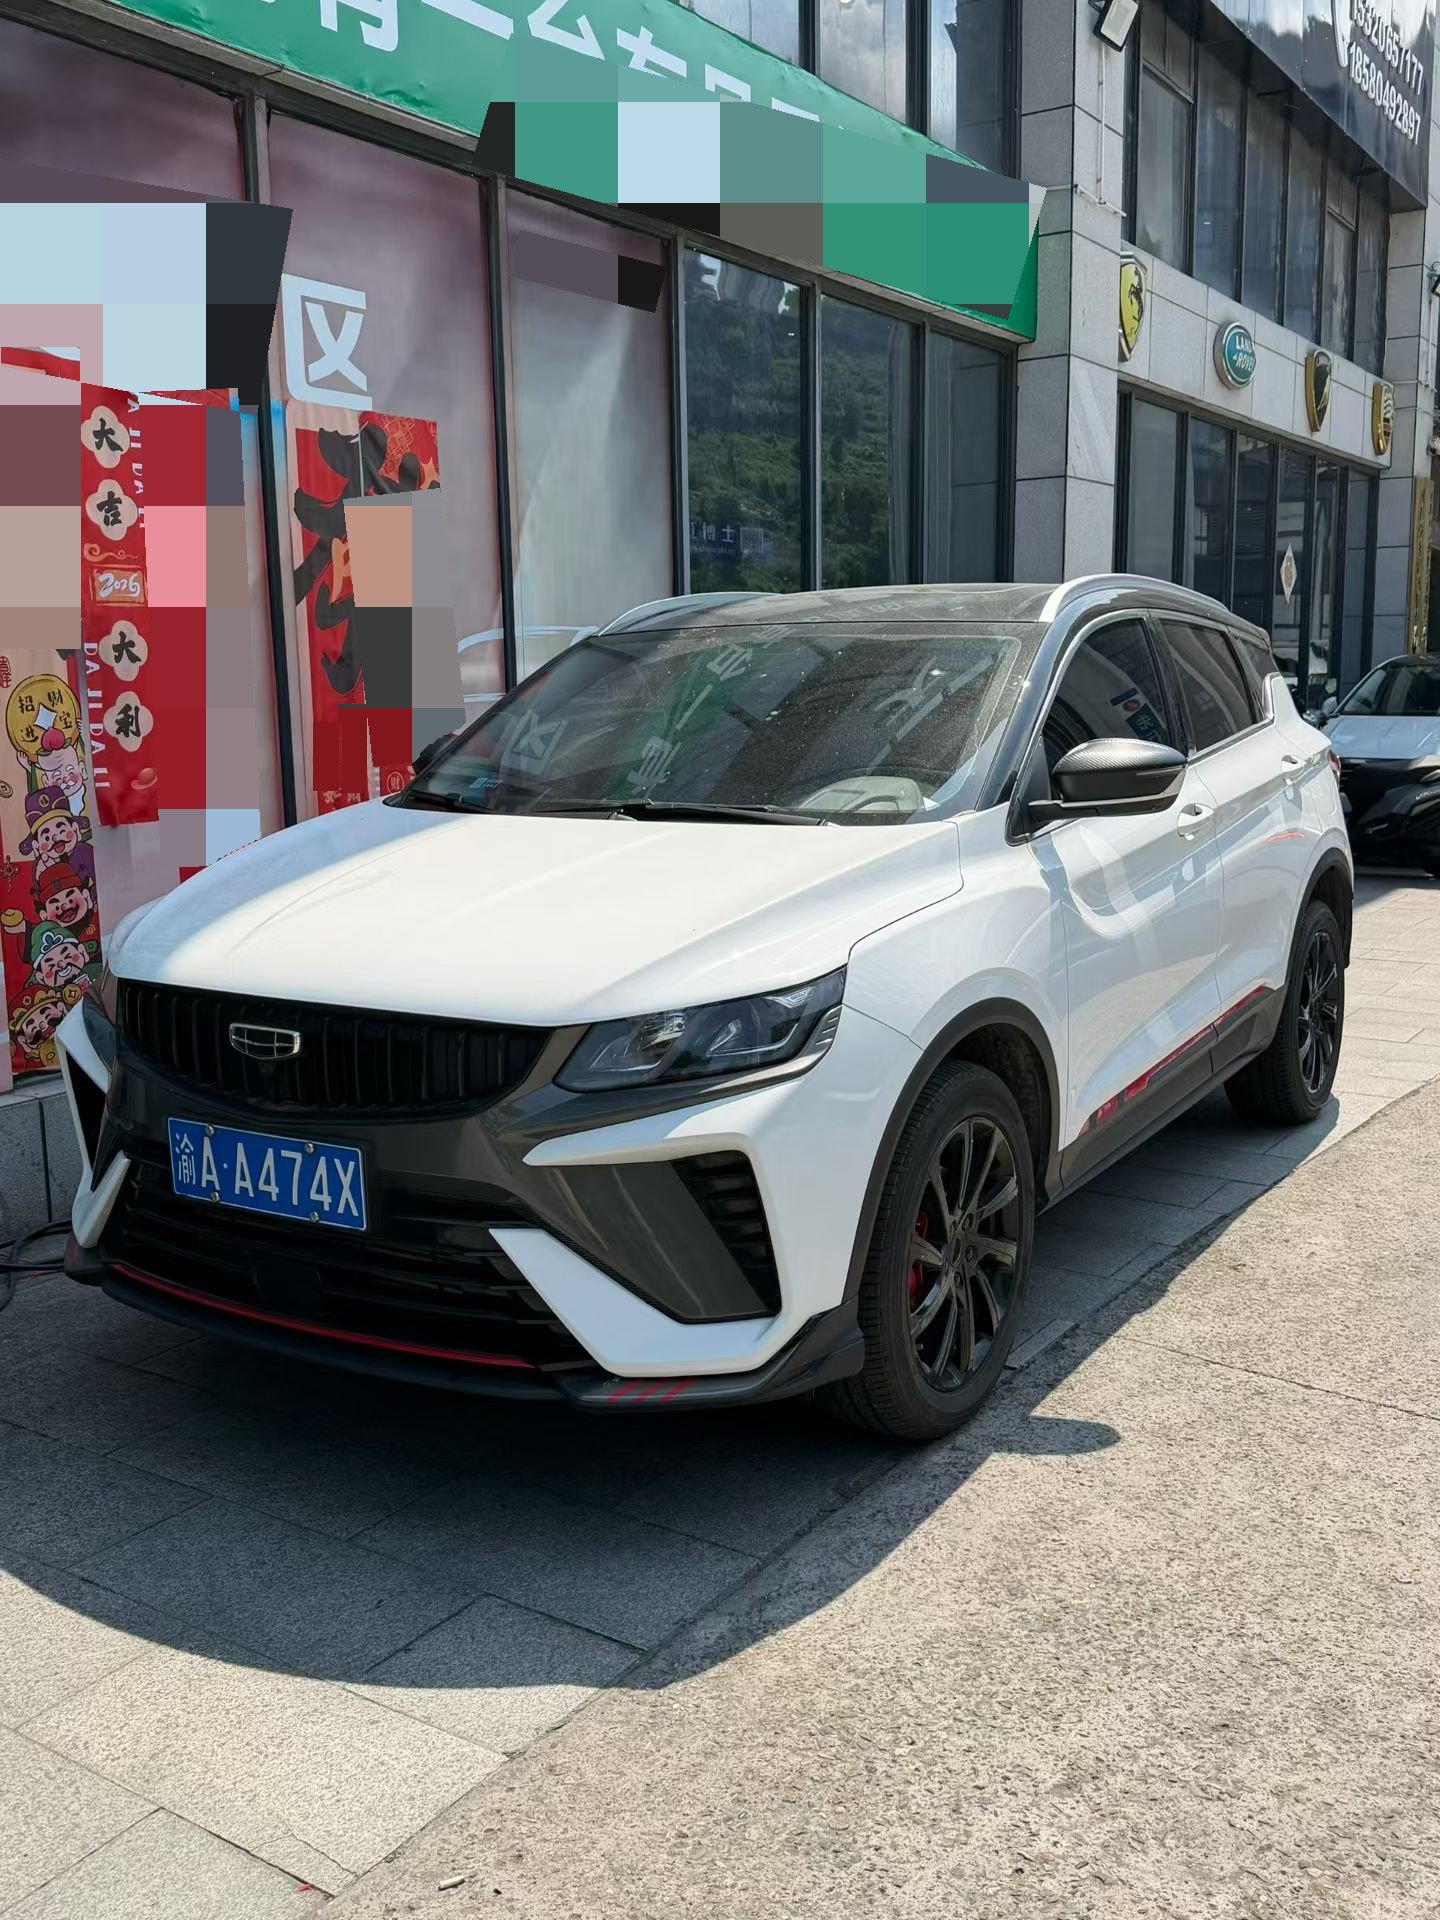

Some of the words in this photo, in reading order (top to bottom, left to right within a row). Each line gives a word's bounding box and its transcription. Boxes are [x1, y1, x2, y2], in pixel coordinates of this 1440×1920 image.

[1349, 41, 1421, 145] 18580492897
[281, 272, 373, 411] 区
[98, 572, 142, 598] 2026
[84, 642, 101, 675] DA
[87, 688, 103, 709] JI
[89, 723, 106, 755] DA
[94, 767, 111, 788] LI
